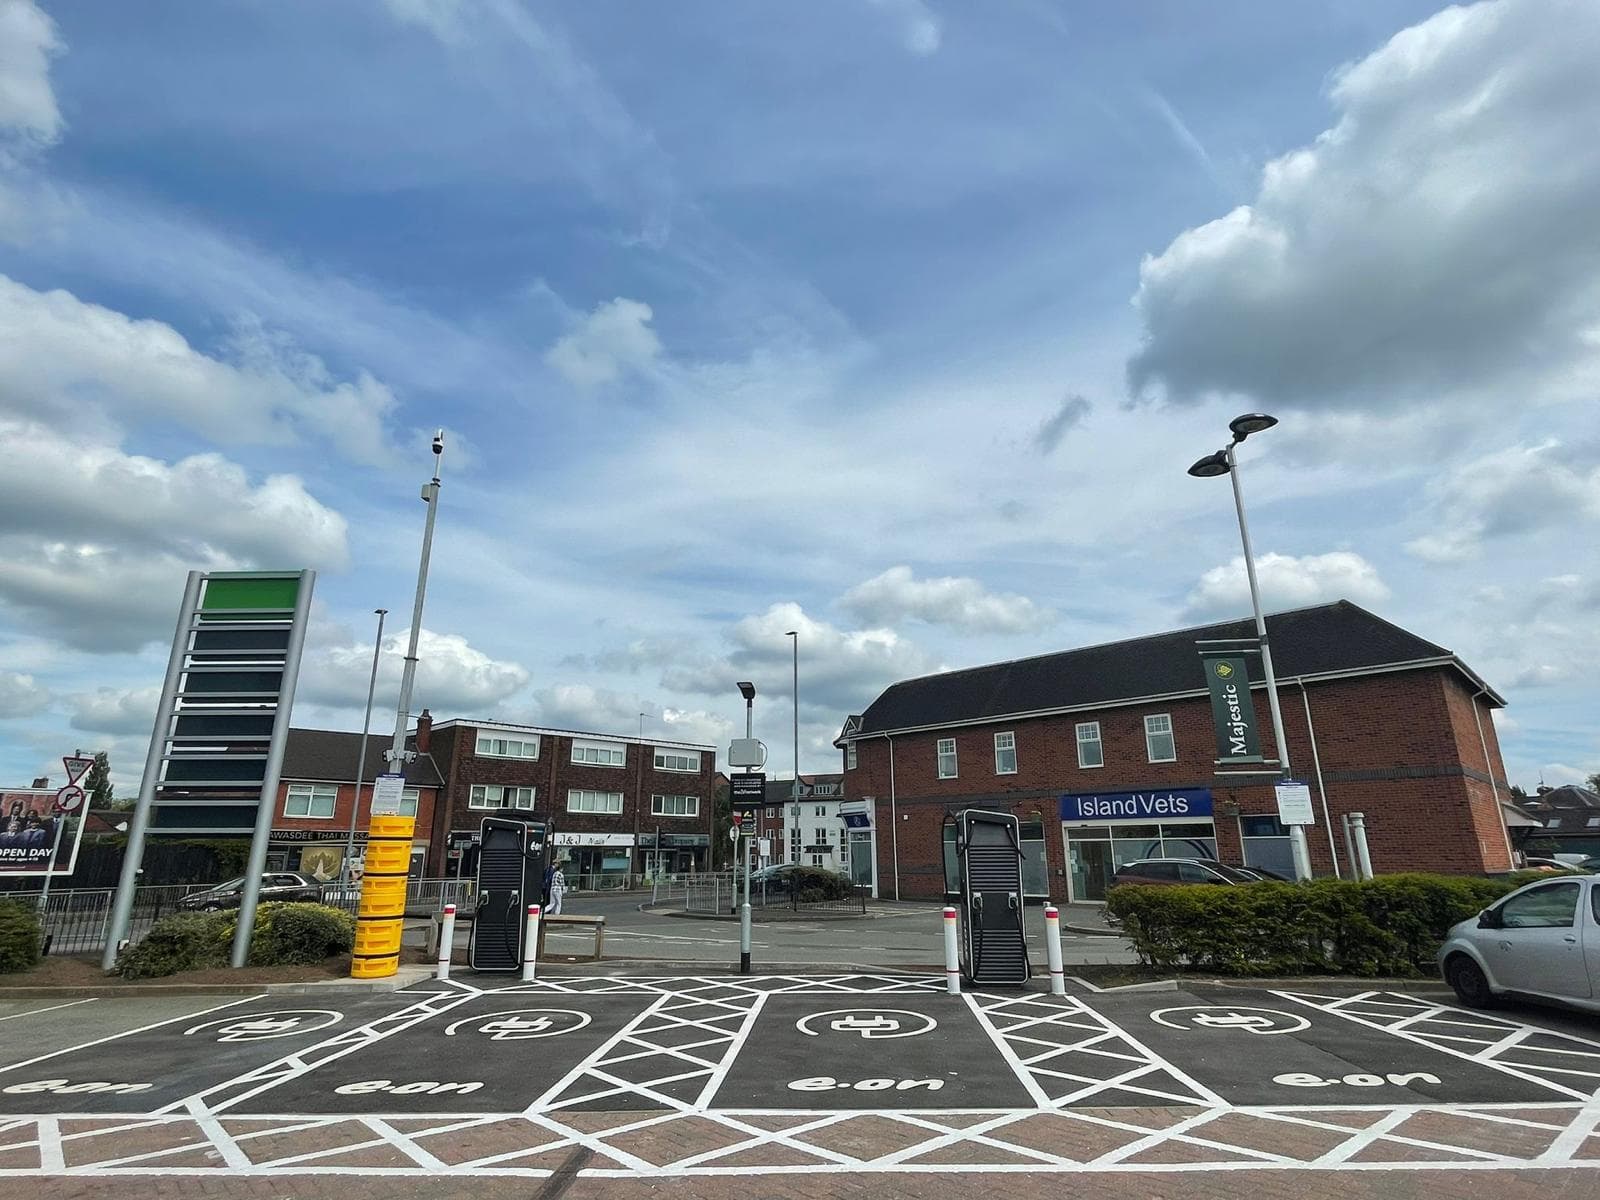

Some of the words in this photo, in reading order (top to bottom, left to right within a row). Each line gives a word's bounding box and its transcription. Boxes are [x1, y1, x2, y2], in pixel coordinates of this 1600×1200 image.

[1222, 684, 1249, 755] Majestic
[1077, 795, 1138, 816] Island
[1138, 793, 1189, 814] Vets
[29, 848, 53, 857] DAY
